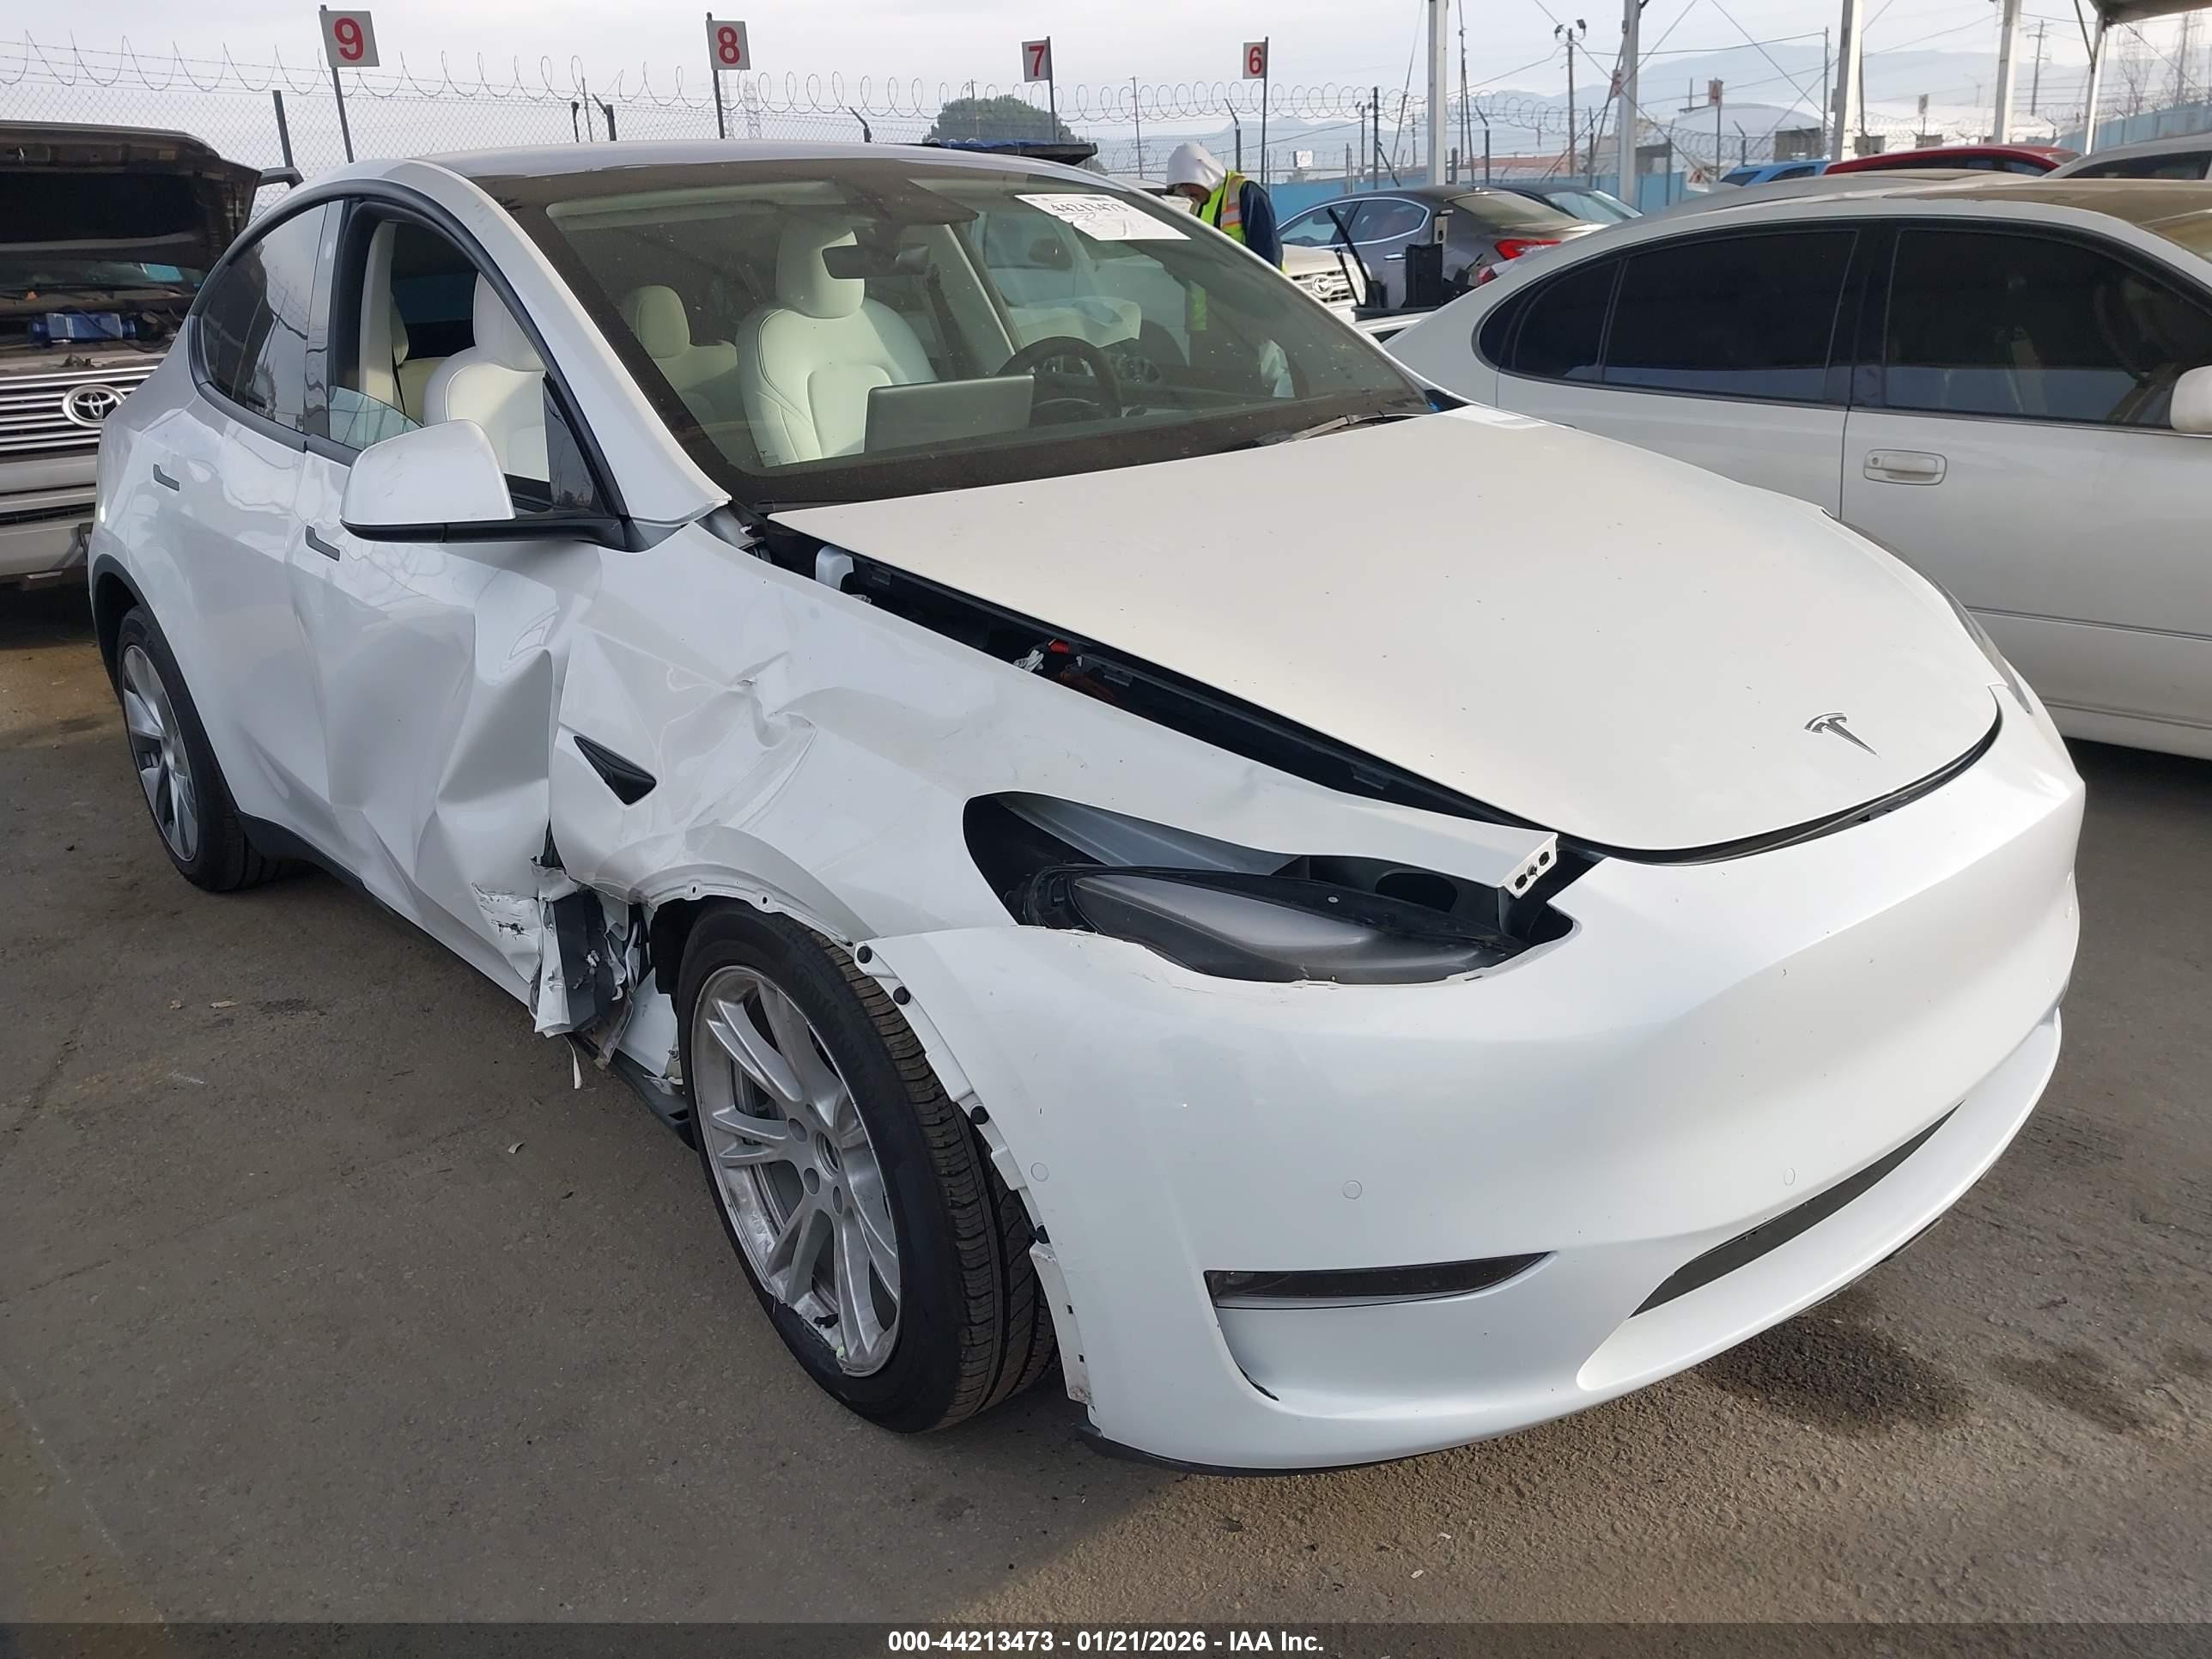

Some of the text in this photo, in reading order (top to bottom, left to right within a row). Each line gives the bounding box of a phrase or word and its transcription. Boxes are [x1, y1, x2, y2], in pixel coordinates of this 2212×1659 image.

[334, 17, 363, 60] 9
[717, 27, 740, 64] 8
[1029, 46, 1044, 76] 7
[1249, 46, 1261, 75] 6
[1050, 203, 1128, 213] 44213473
